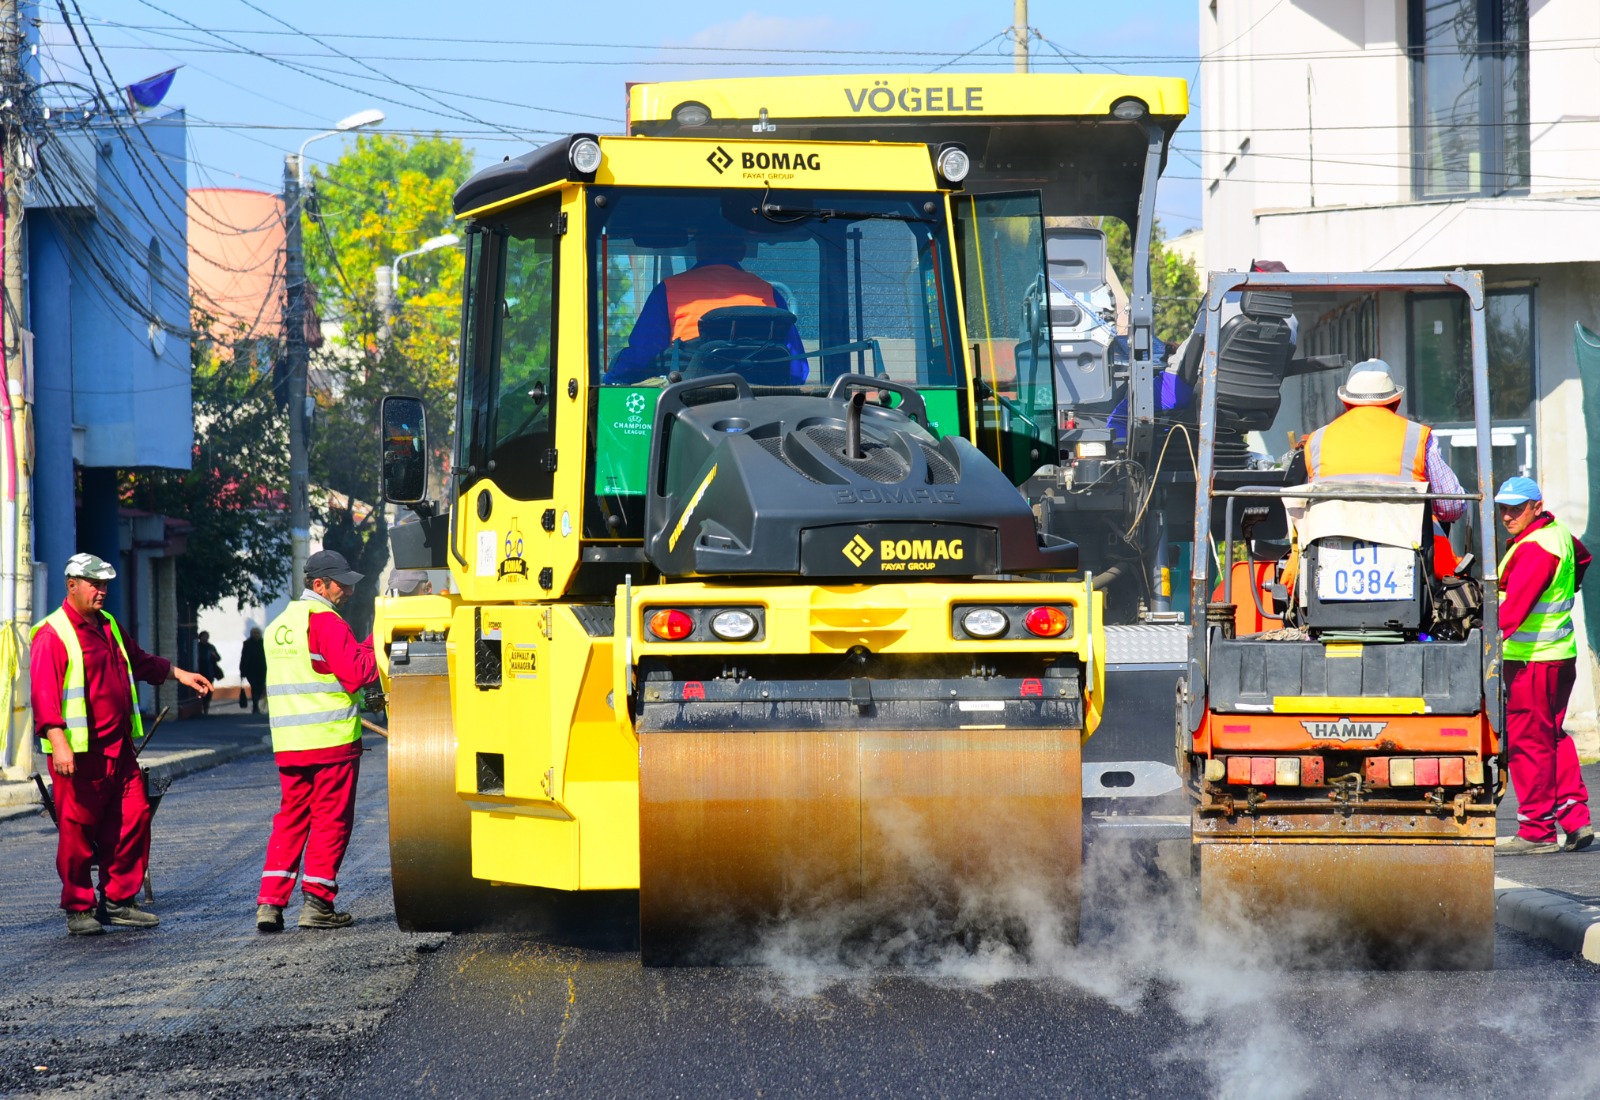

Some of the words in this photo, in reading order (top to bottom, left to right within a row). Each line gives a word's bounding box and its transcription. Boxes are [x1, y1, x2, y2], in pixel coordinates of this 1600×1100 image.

[844, 80, 984, 113] VÖGELE
[742, 152, 821, 170] BOMAG
[613, 422, 652, 430] CHAMPION
[831, 487, 960, 505] BOMAG
[880, 539, 964, 561] BOMAG
[1352, 539, 1382, 565] CT
[881, 563, 906, 571] FAYAT
[907, 562, 936, 571] GROUP
[1335, 569, 1398, 595] 0384
[511, 652, 529, 660] ASPHALT
[530, 653, 536, 670] 2
[511, 661, 530, 670] MANAGER
[1315, 724, 1373, 737] HAMM
